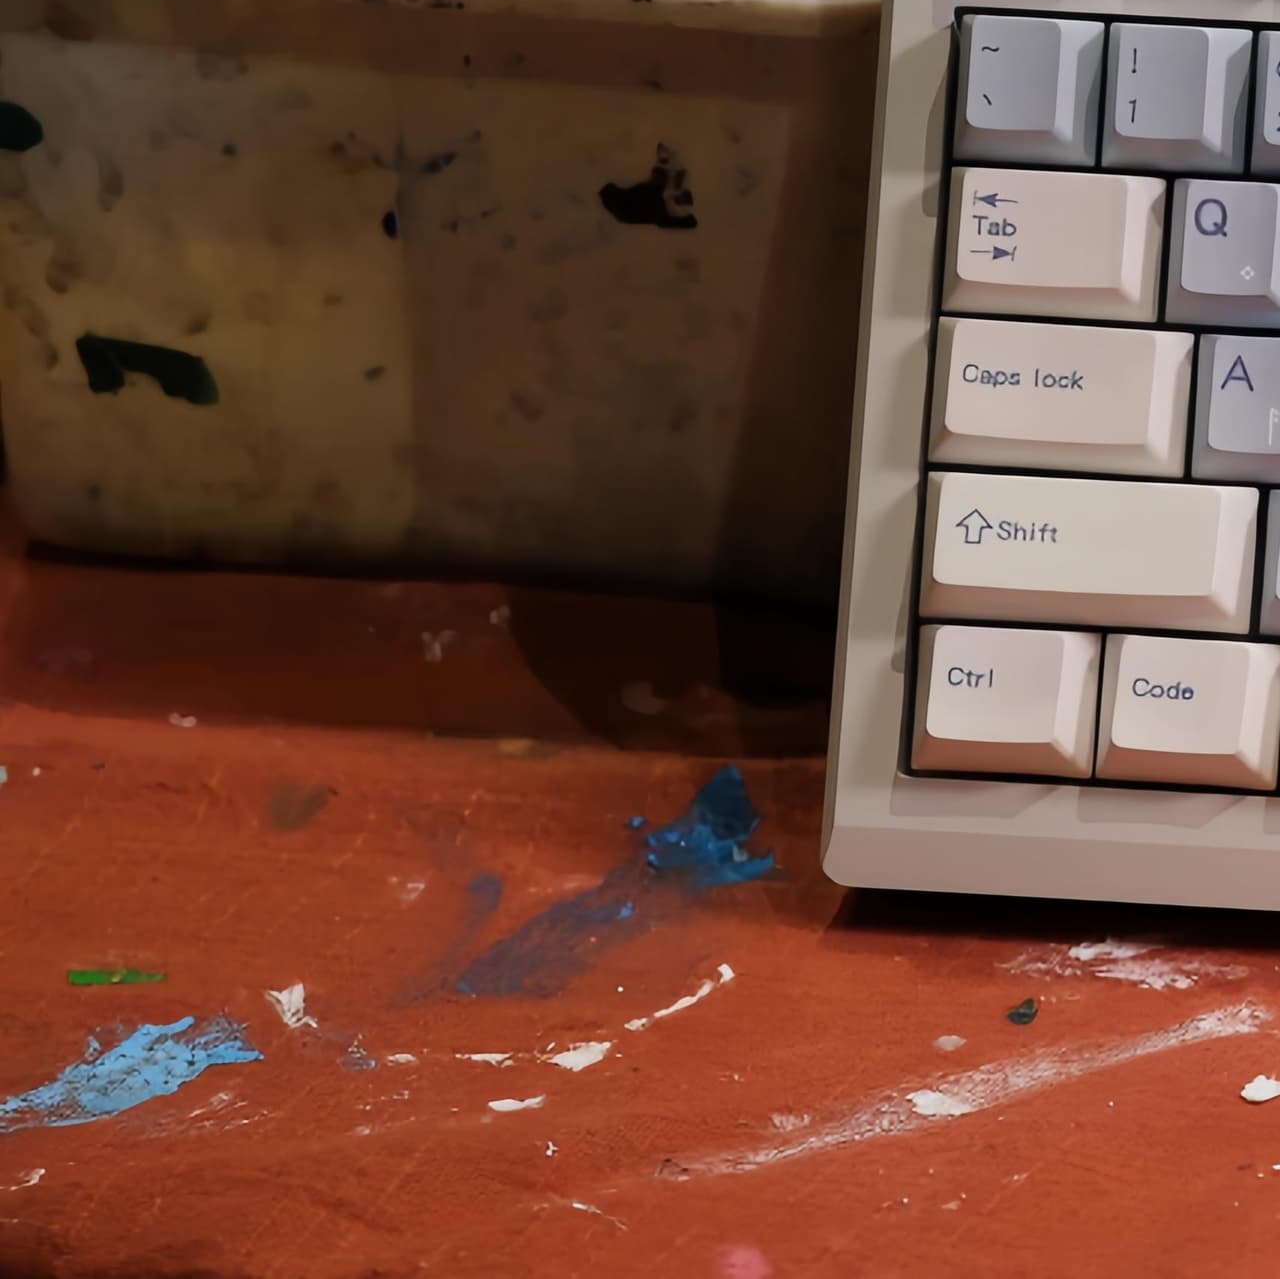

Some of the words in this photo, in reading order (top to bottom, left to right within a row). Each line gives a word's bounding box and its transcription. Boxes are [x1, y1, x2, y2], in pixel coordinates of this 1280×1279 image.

[1128, 98, 1137, 123] 1
[972, 214, 1017, 237] Tab
[1194, 198, 1228, 238] Q
[962, 363, 1021, 389] Caps
[1034, 368, 1084, 391] lock
[1220, 354, 1255, 393] A
[996, 520, 1058, 544] Shift
[947, 666, 994, 688] Ctrl
[1132, 677, 1195, 701] Code
